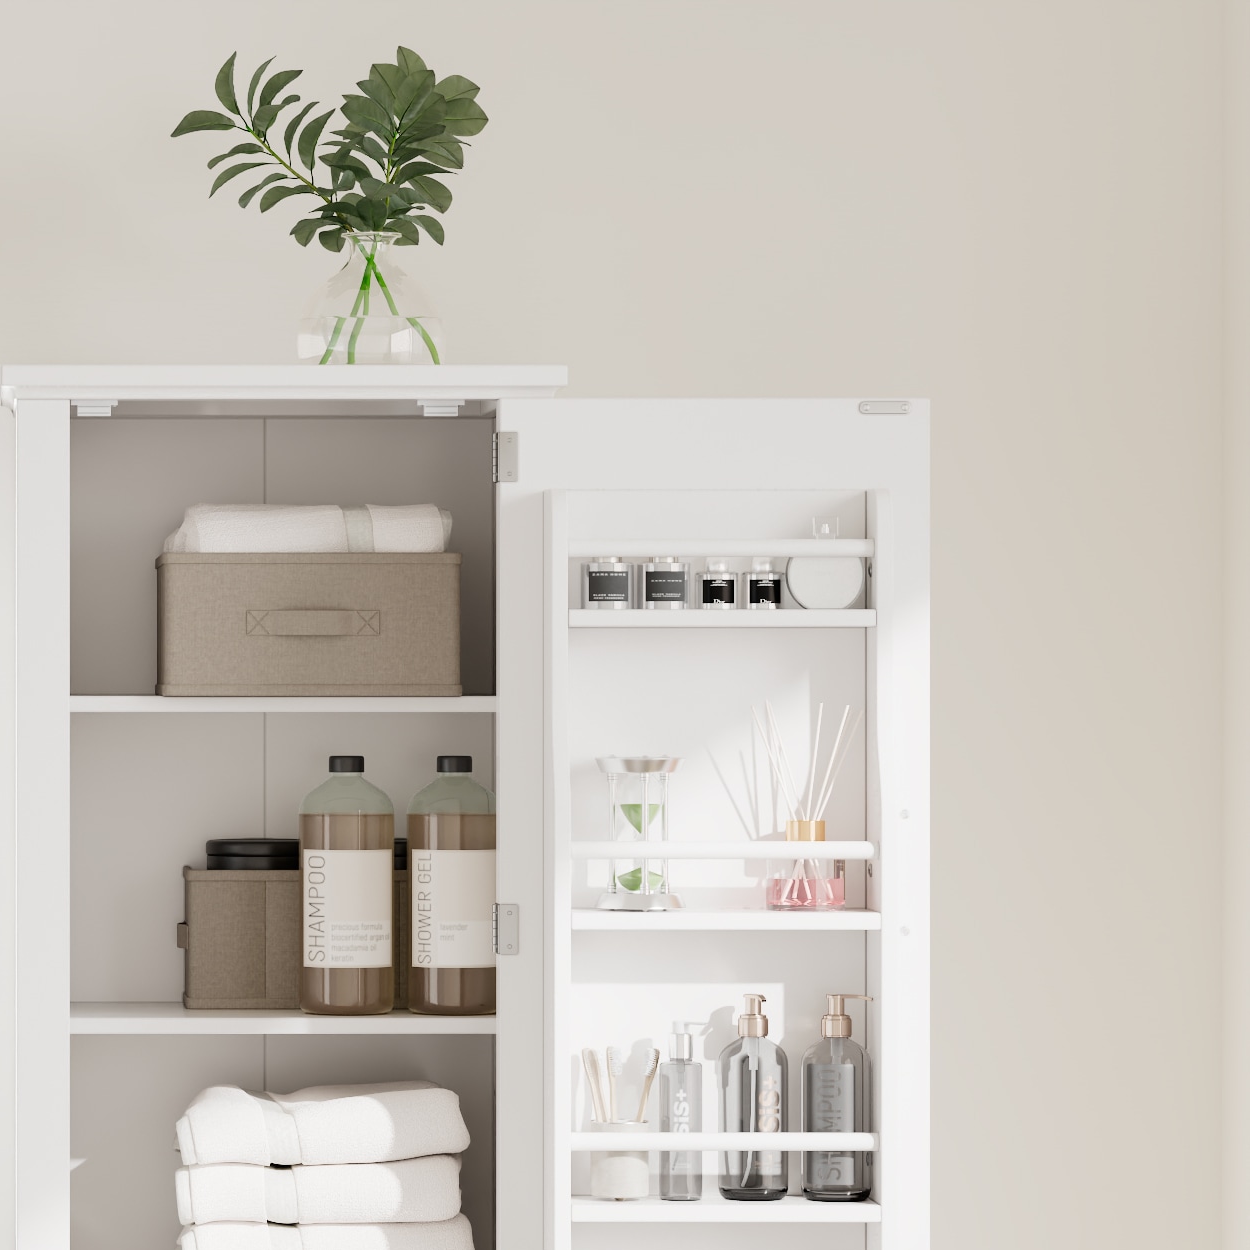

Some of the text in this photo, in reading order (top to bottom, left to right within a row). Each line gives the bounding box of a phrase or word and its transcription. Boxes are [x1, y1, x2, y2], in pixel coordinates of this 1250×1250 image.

[308, 856, 325, 961] SHAMPOO
[418, 853, 431, 964] SHOWER GEL
[817, 1070, 842, 1180] SHMPOO
